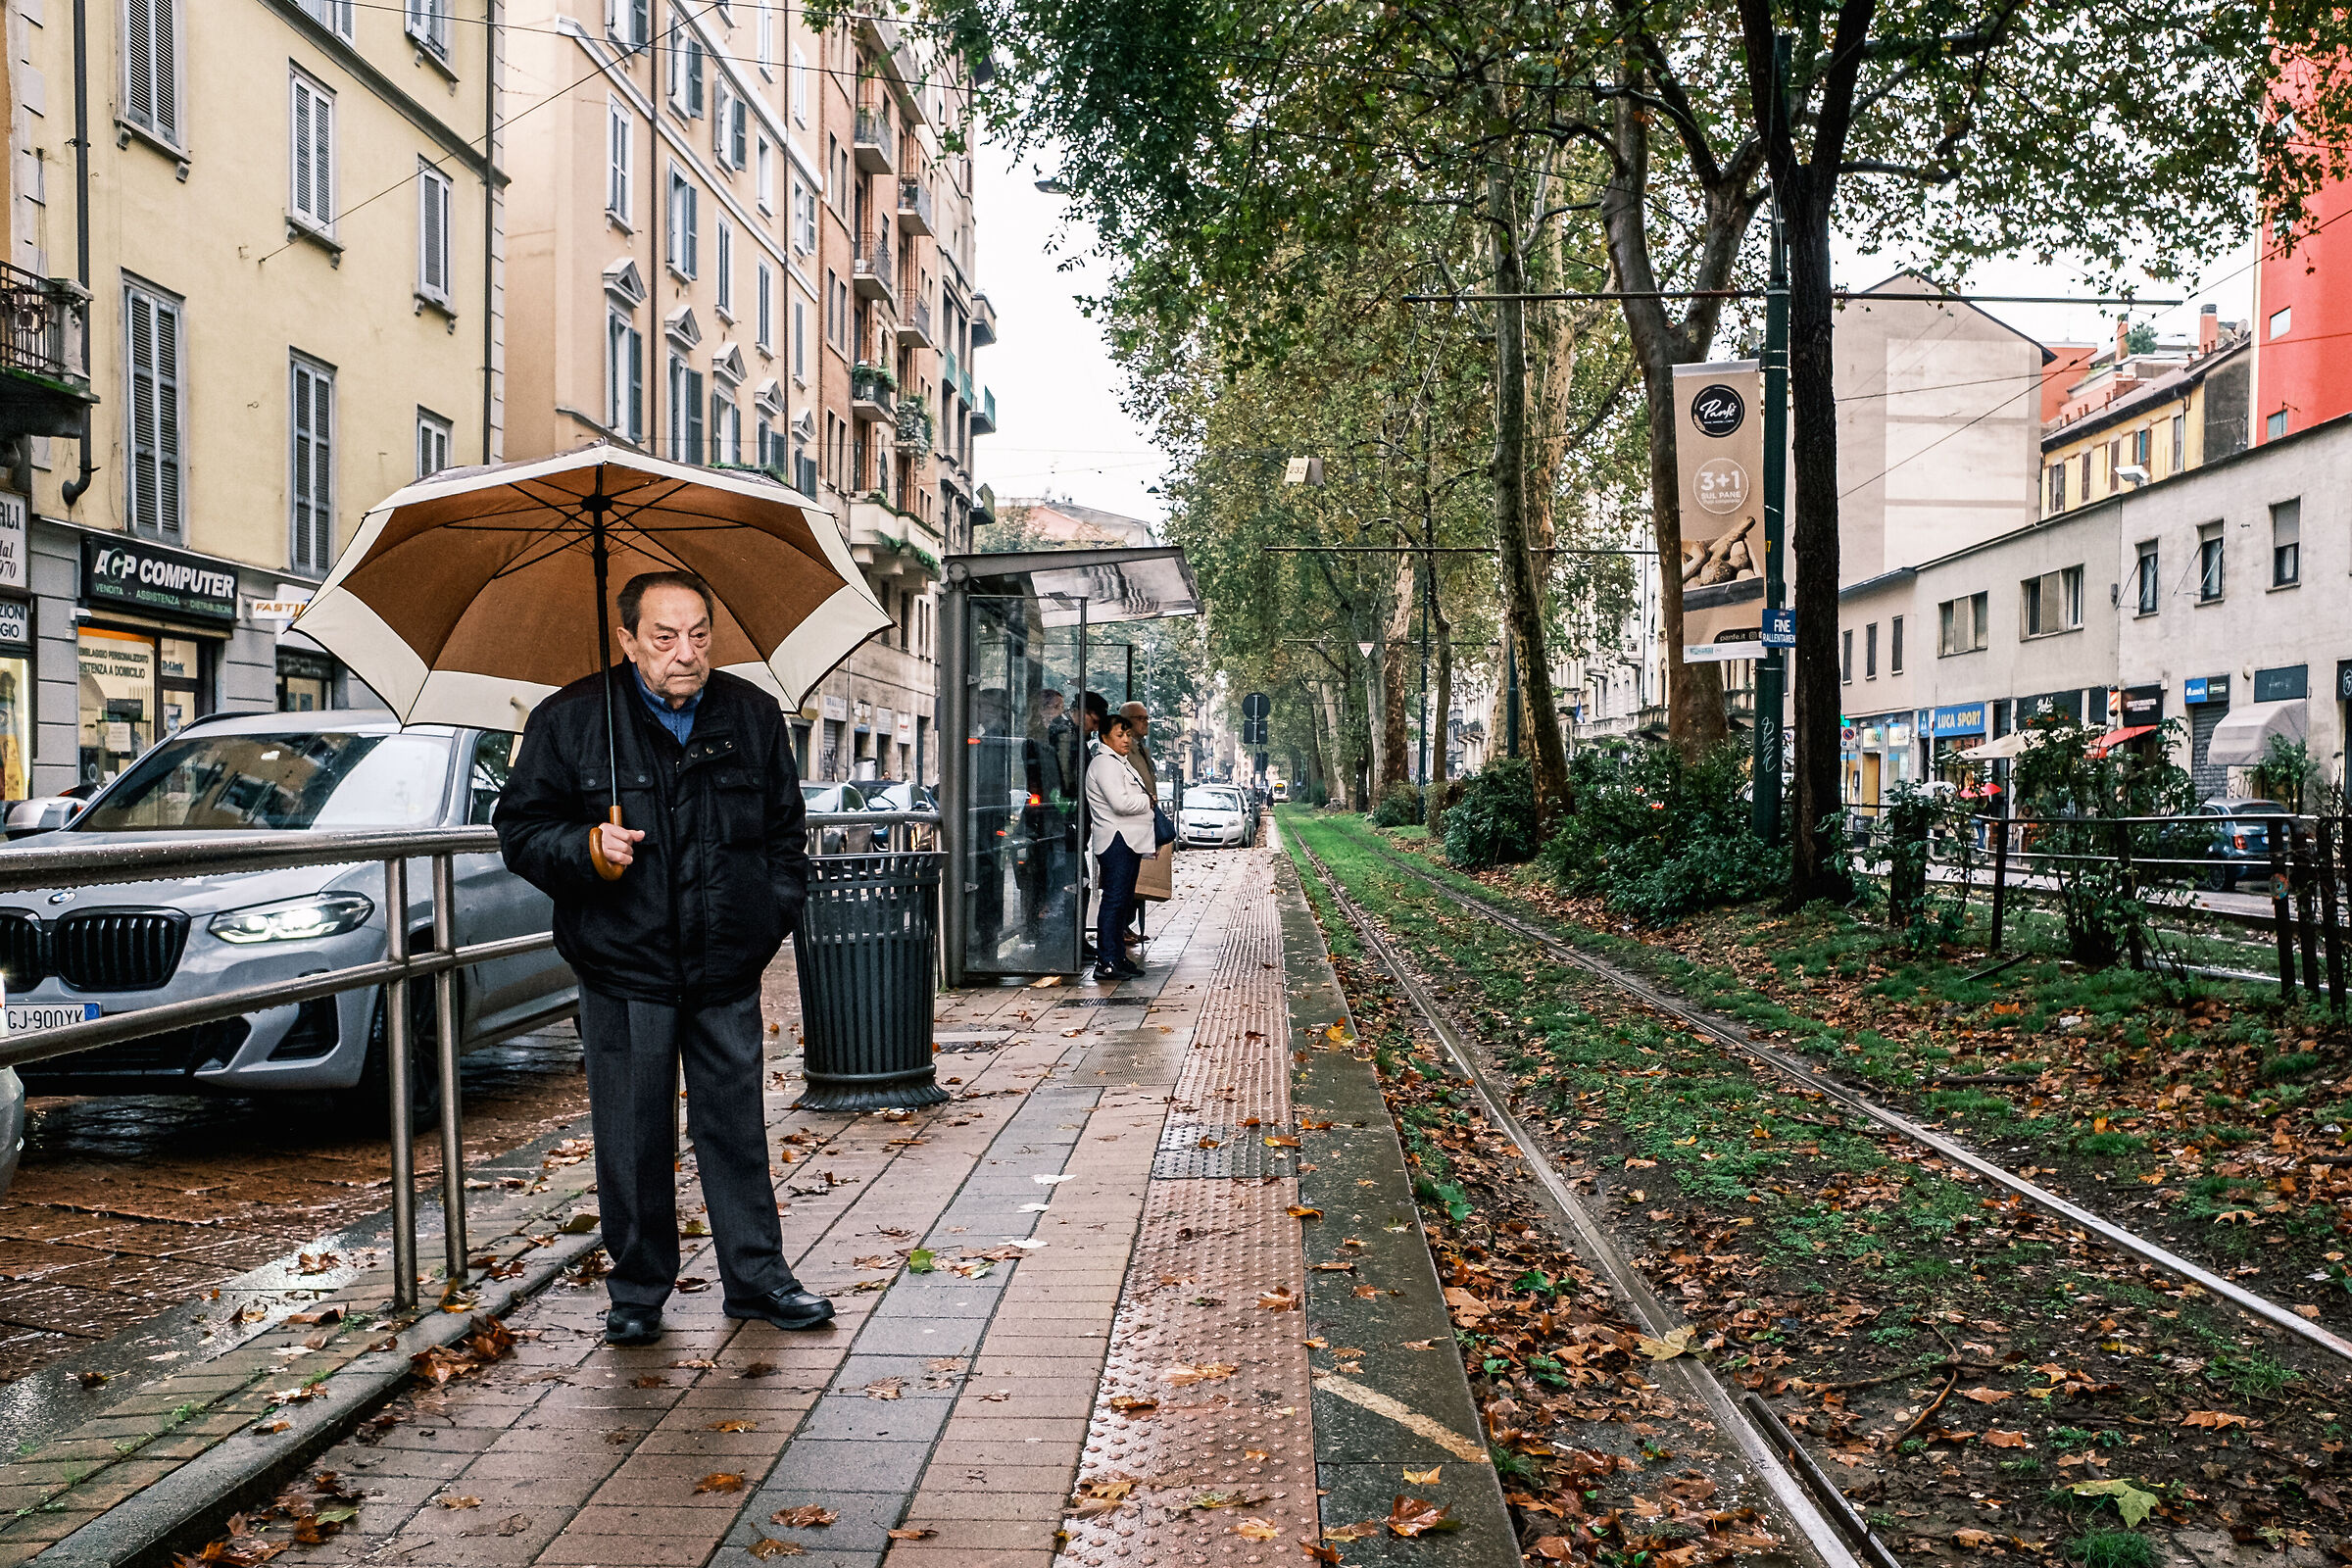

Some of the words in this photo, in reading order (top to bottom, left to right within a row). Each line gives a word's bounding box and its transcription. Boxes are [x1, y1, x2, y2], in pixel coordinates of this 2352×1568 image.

[1700, 470, 1740, 490] 3+1
[139, 559, 235, 599] COMPUTER
[95, 583, 123, 596] VENDITA
[135, 590, 180, 606] ASSISTENZA
[1774, 618, 1791, 633] FINE
[115, 666, 146, 679] DOMICILIO
[1937, 713, 1955, 729] LUCA
[1957, 710, 1981, 727] SPORT
